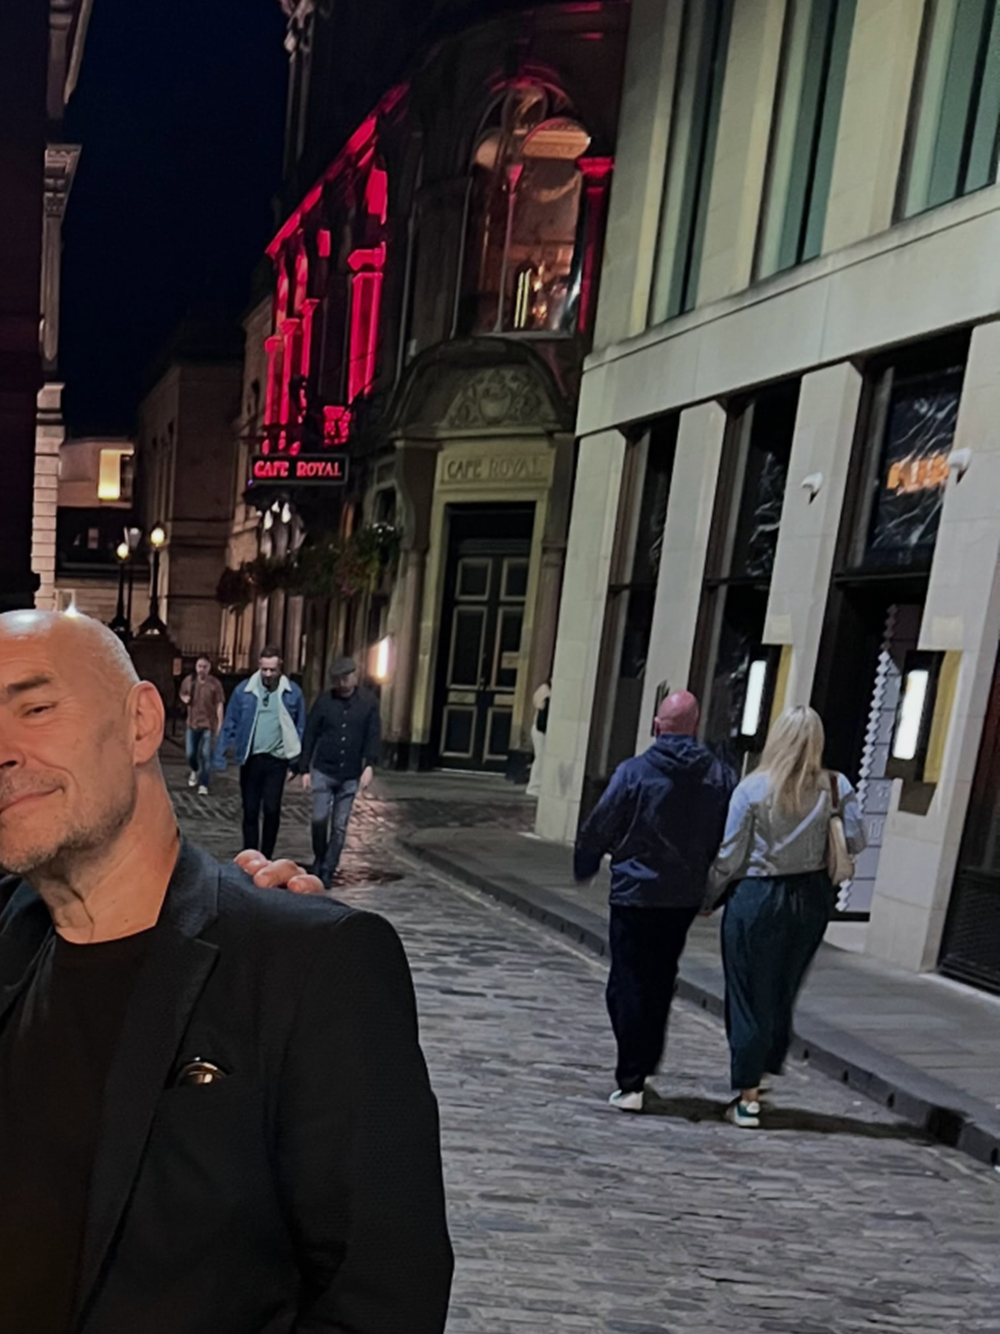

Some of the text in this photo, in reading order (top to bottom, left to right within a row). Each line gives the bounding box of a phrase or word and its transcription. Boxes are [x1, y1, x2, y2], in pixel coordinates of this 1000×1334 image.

[254, 461, 341, 477] CAFE ROYAL
[447, 456, 541, 478] CAFE ROYAL
